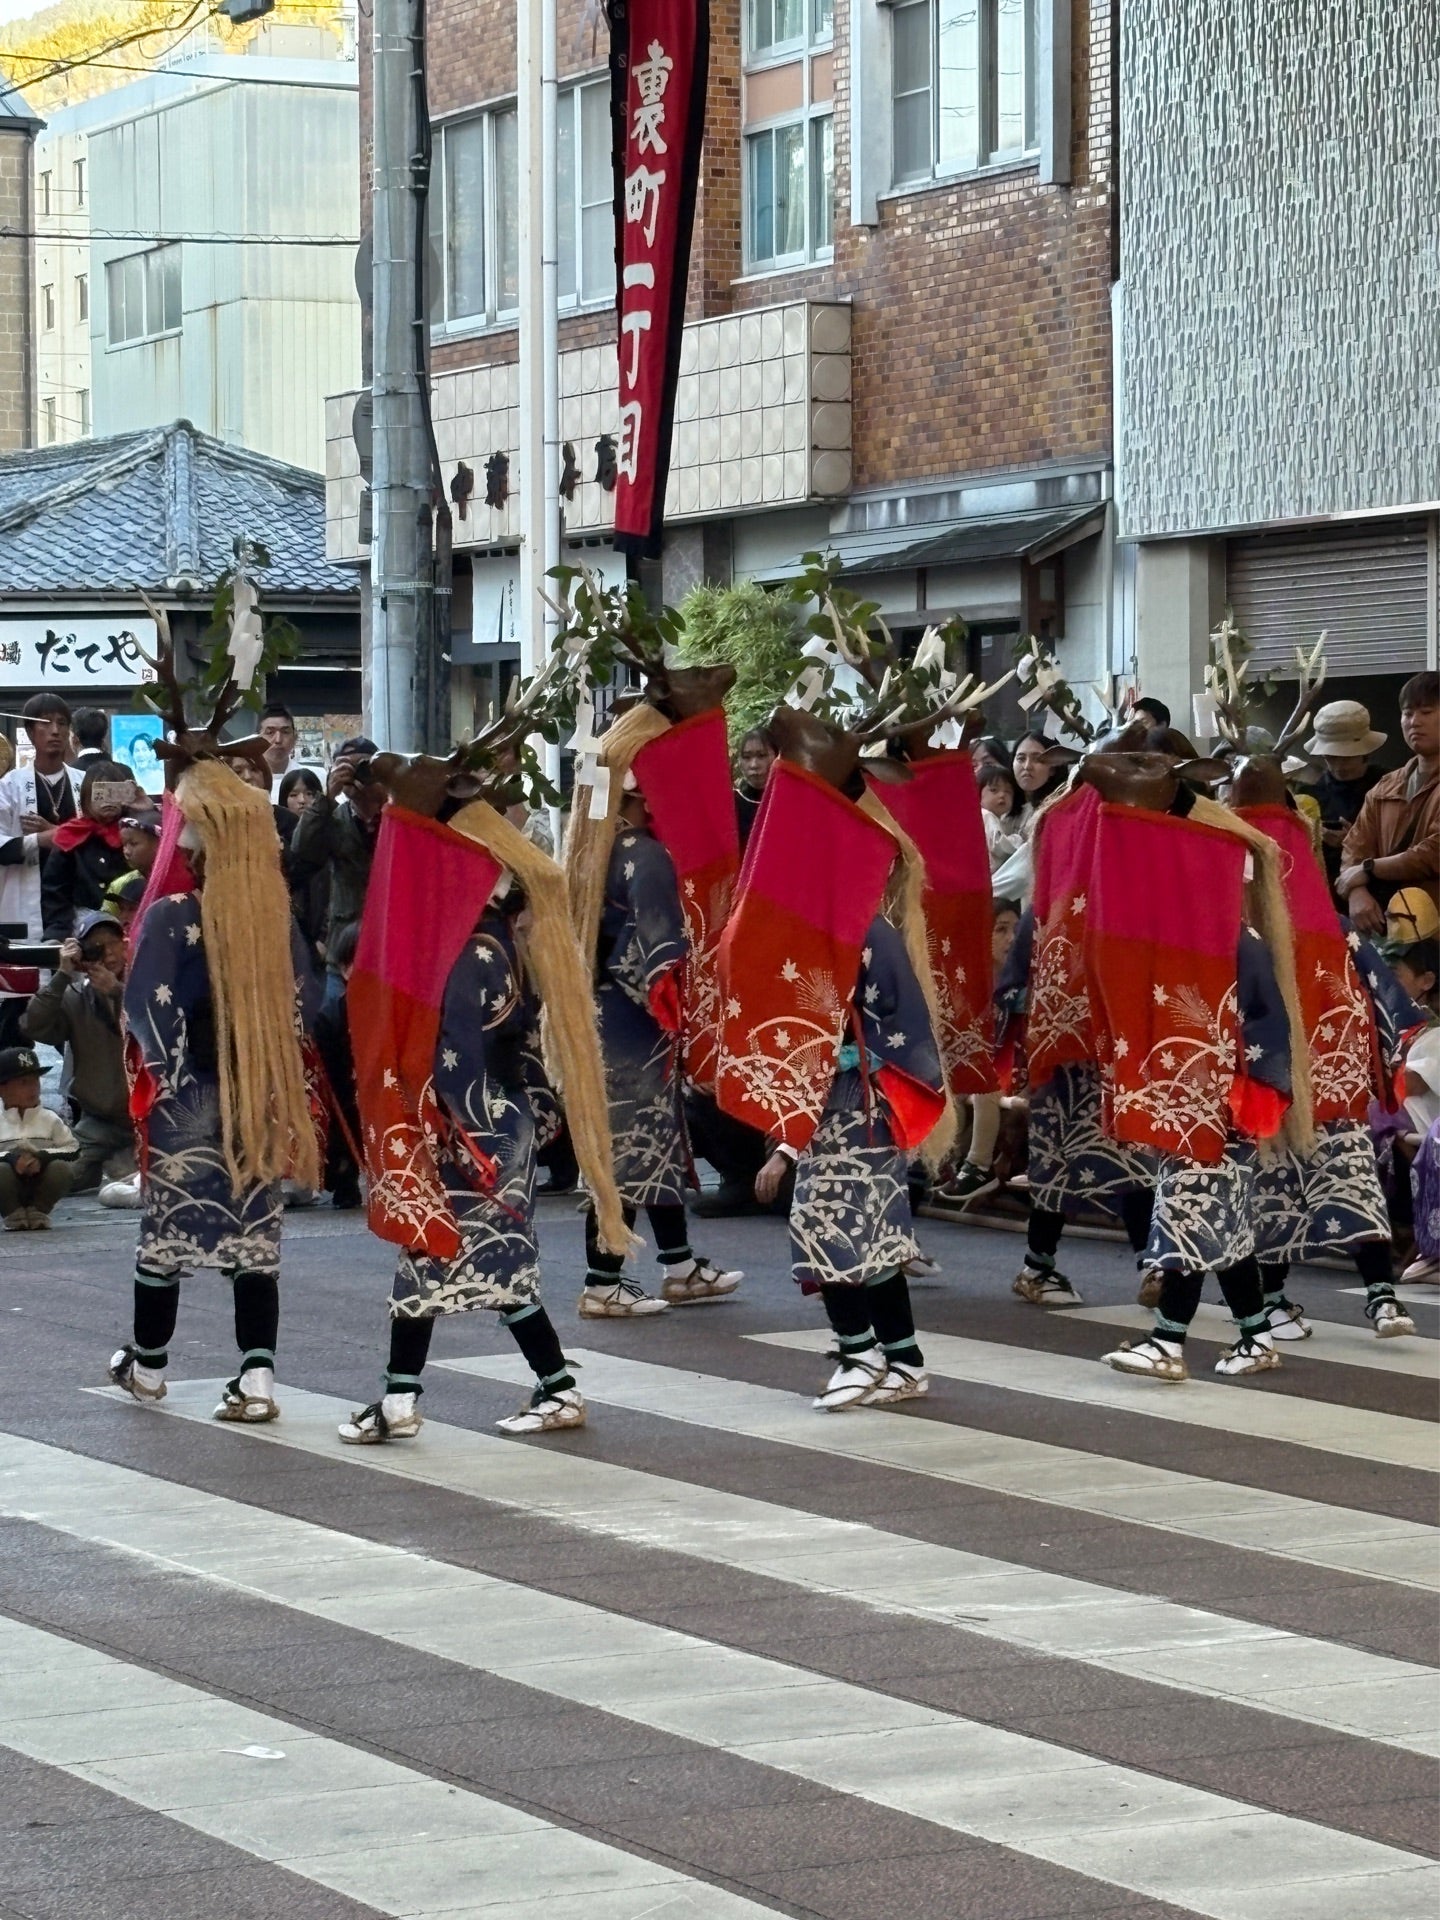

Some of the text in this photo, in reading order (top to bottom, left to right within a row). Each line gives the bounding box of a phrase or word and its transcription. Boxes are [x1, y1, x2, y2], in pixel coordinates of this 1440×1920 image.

[616, 38, 674, 486] 裏町一丁目
[33, 629, 142, 677] だてや
